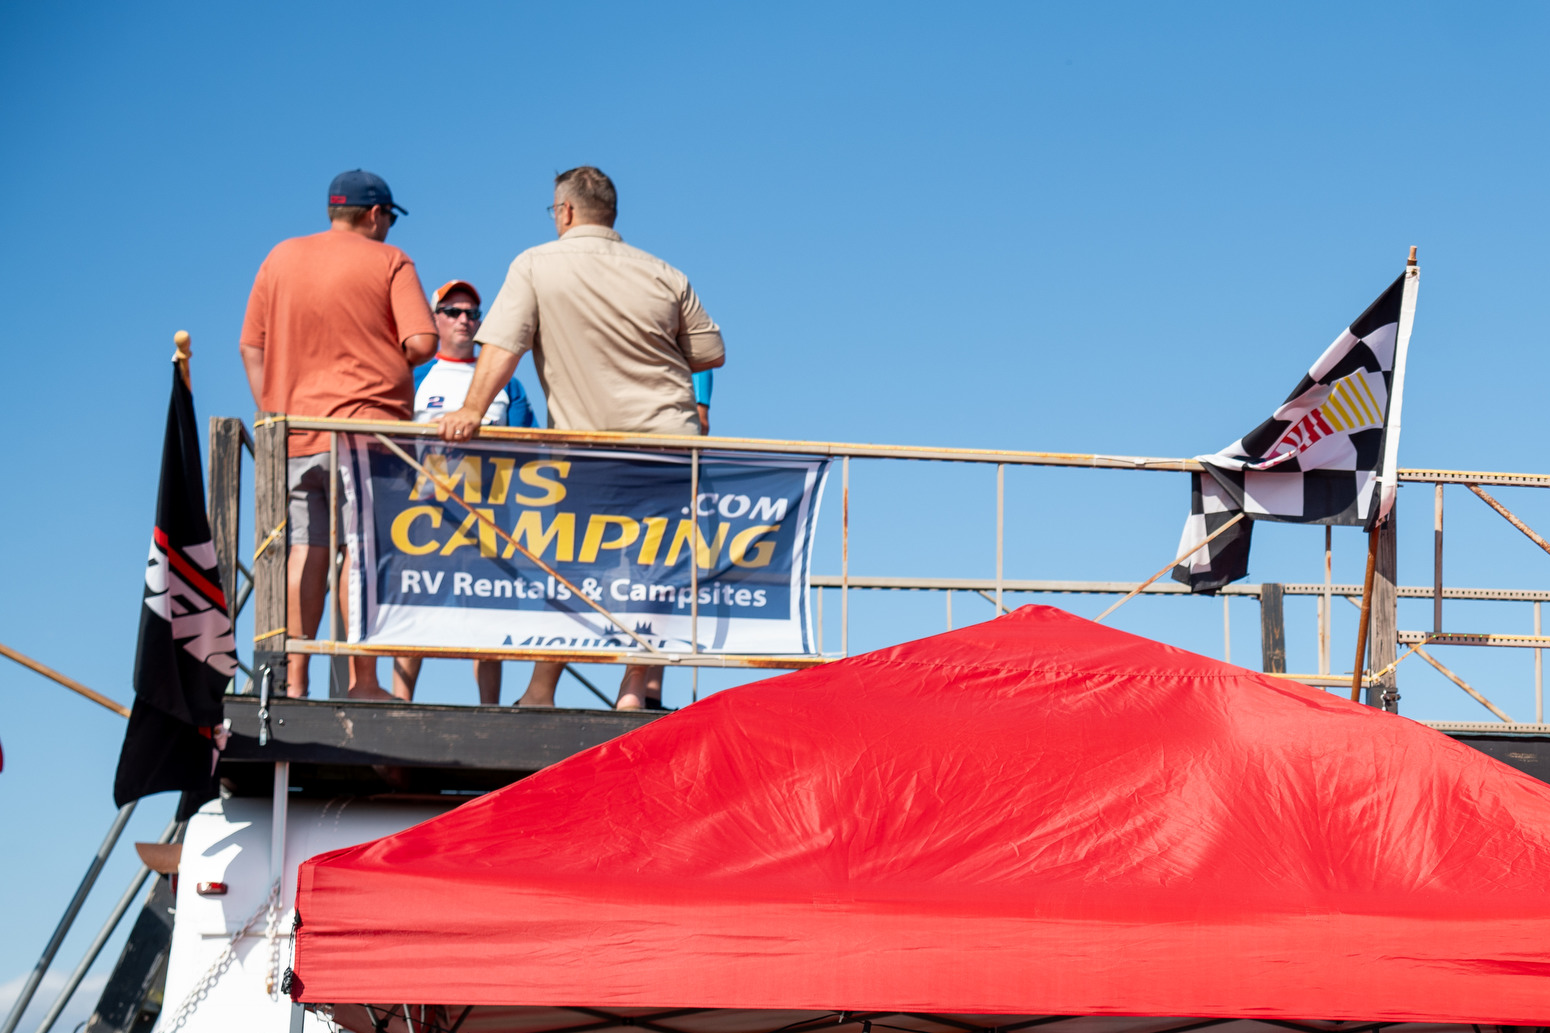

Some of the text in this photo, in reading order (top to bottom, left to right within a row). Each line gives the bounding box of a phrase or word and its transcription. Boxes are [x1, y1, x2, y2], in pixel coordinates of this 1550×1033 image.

[408, 454, 572, 507] MIS
[681, 492, 788, 522] .COM
[390, 505, 781, 569] CAMPING
[401, 569, 767, 609] RV Rentals & Campsites
